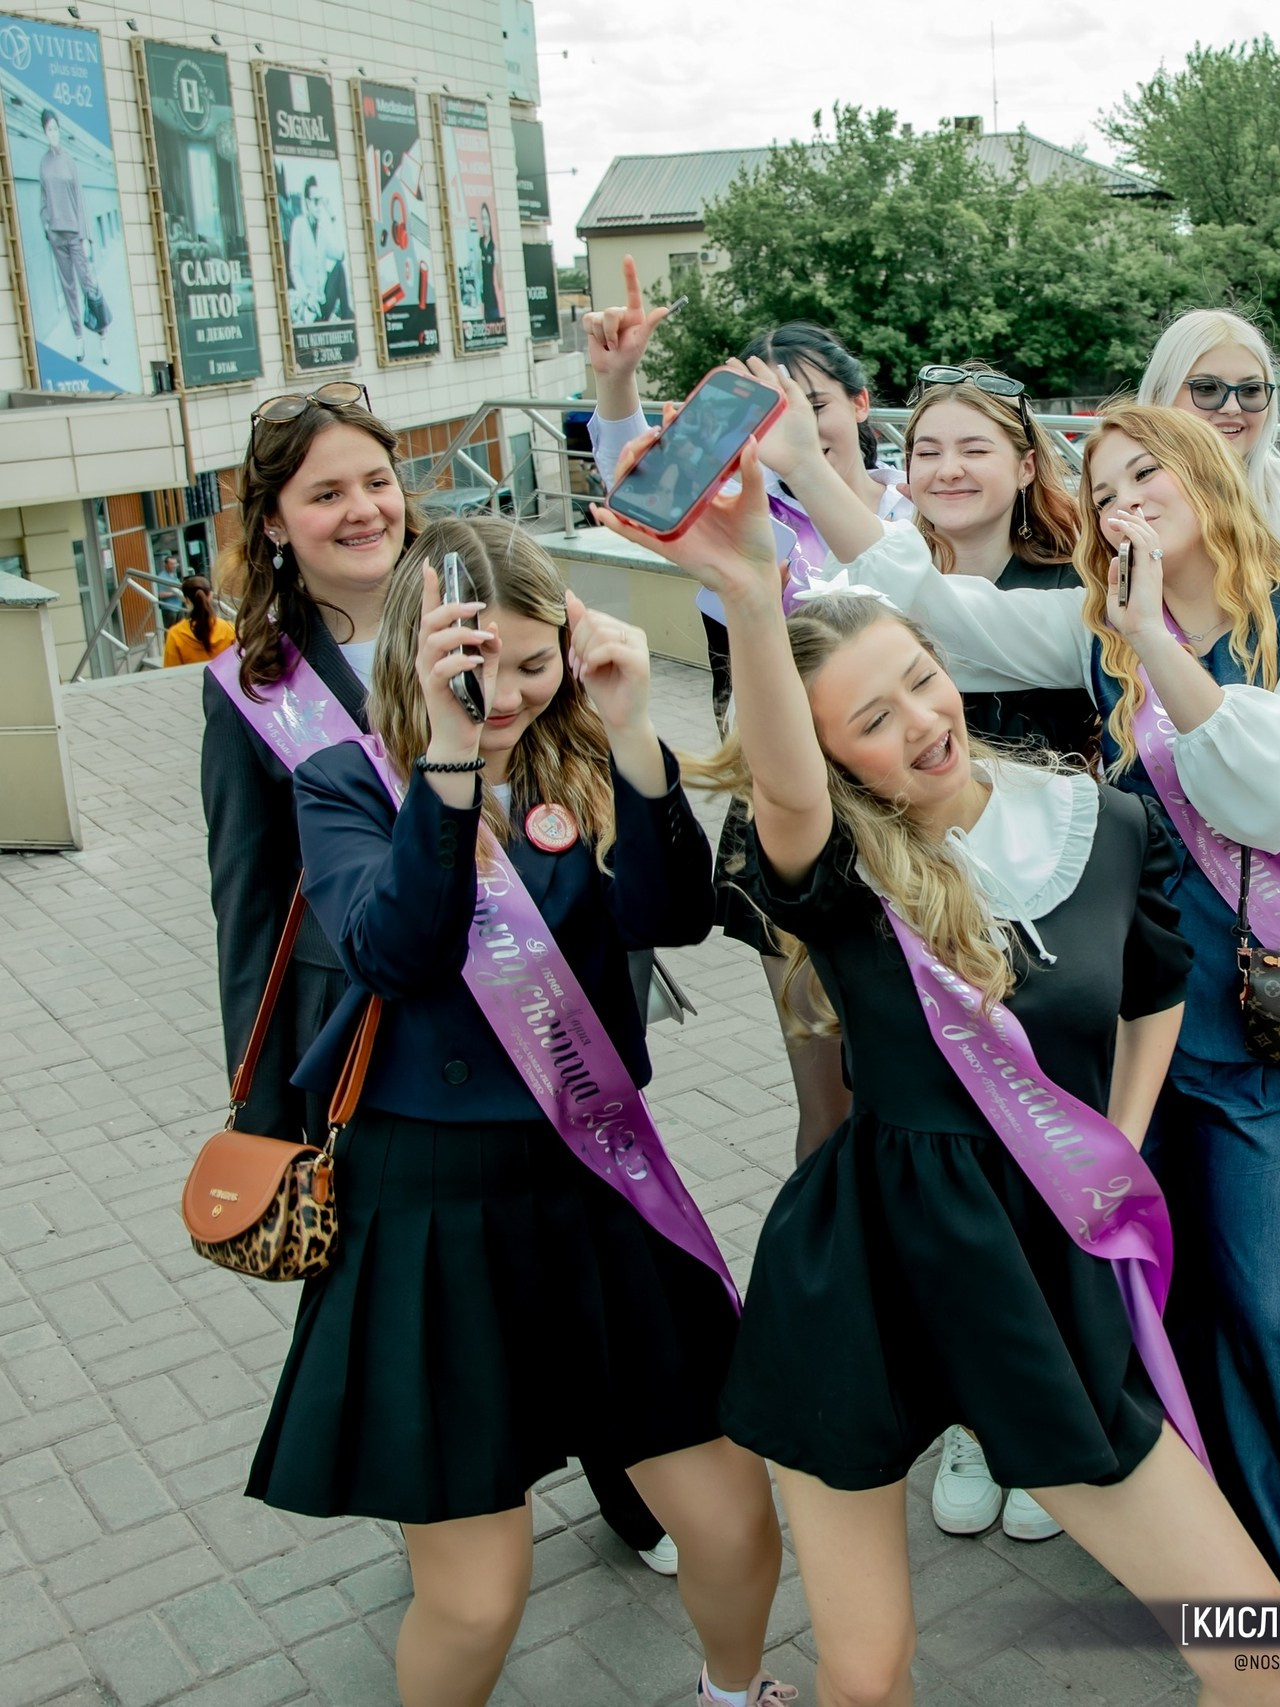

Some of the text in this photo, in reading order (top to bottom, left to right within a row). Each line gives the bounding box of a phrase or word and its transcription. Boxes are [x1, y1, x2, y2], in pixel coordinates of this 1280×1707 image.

[32, 33, 99, 64] VIVIEN
[54, 82, 94, 107] 48-62
[180, 258, 242, 287] САЛОН
[188, 293, 242, 320] ШТОР
[206, 325, 243, 343] ДЕКОРА
